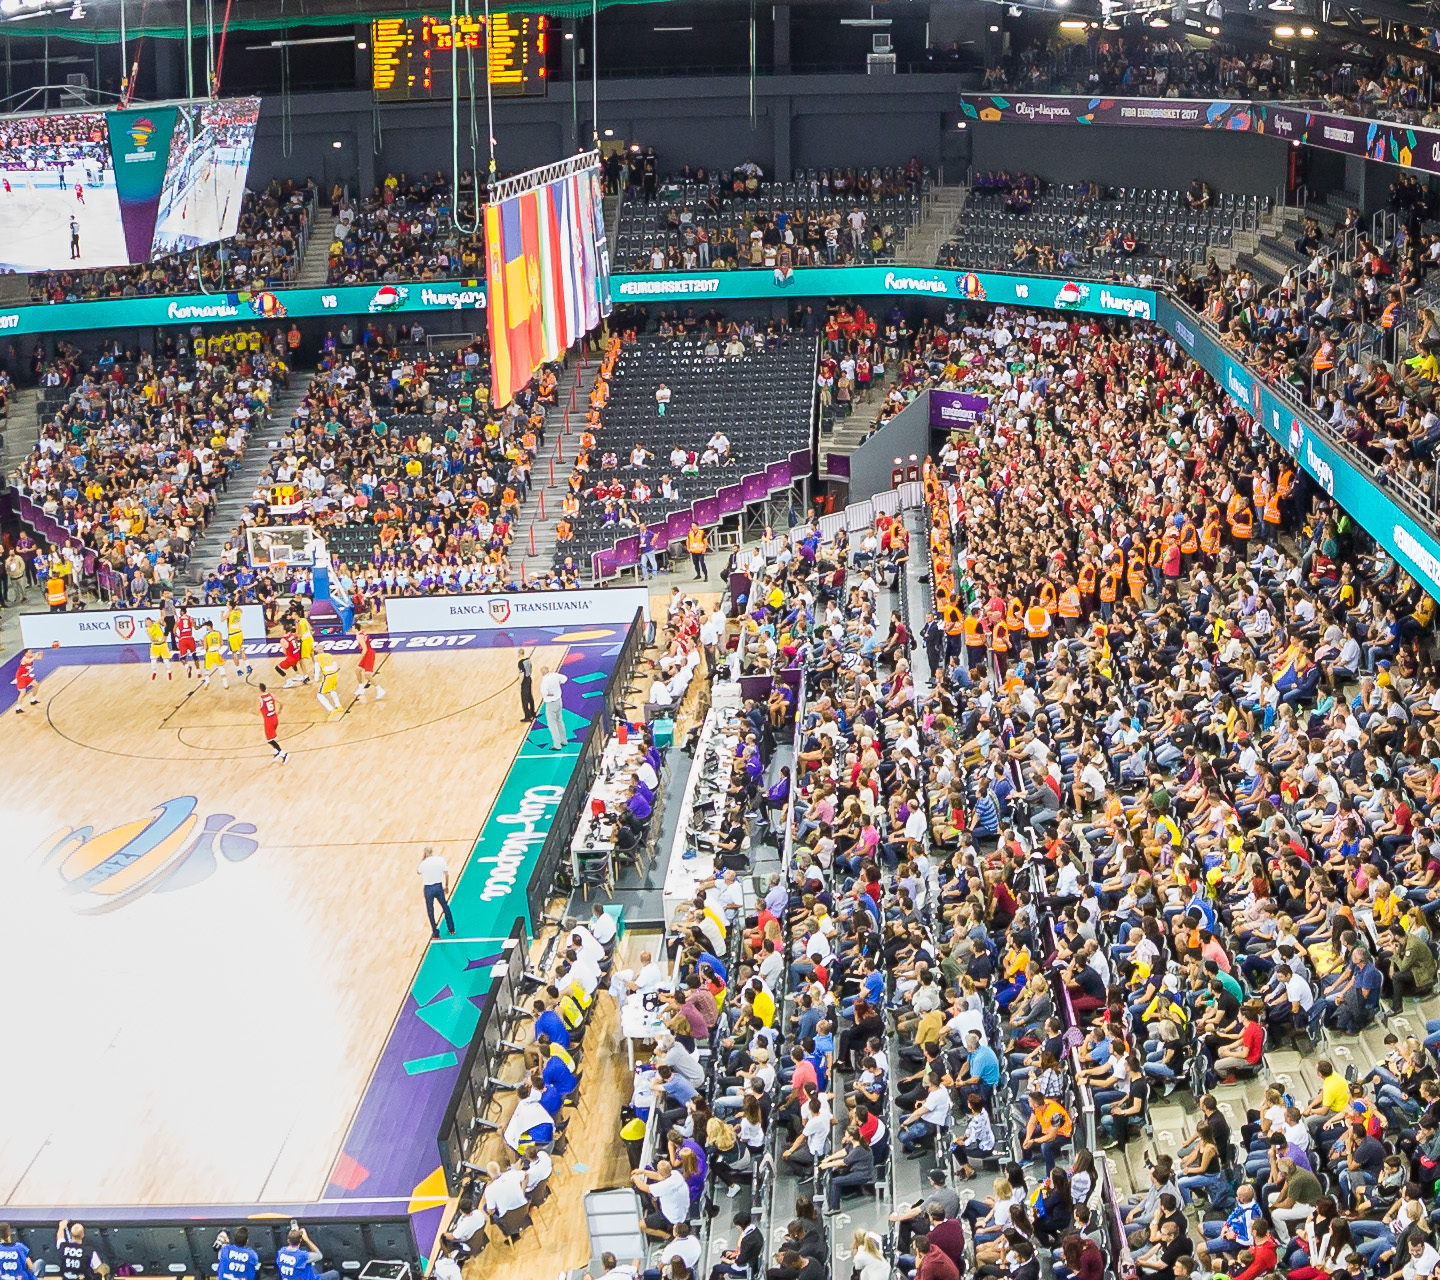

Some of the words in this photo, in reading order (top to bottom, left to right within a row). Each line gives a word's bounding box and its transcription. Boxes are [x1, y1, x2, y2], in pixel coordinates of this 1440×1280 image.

[1015, 102, 1071, 118] Cluj-Napoca
[1121, 107, 1136, 117] FIBA
[1137, 108, 1180, 119] EUROBASKET
[1182, 109, 1198, 120] 2017
[619, 279, 719, 295] #EUROBASKET2017
[884, 272, 947, 292] Romania
[322, 295, 337, 308] VS
[421, 289, 486, 309] Hungary
[1100, 290, 1150, 320] Hungary
[168, 300, 238, 318] Romania
[1307, 438, 1334, 496] Hungary
[450, 605, 484, 616] BANCA
[514, 602, 589, 613] TRANSILVANIA
[79, 621, 110, 631] BANCA
[406, 634, 476, 649] 2017
[478, 785, 564, 901] Cluj-Napoca
[229, 1250, 249, 1262] PHO
